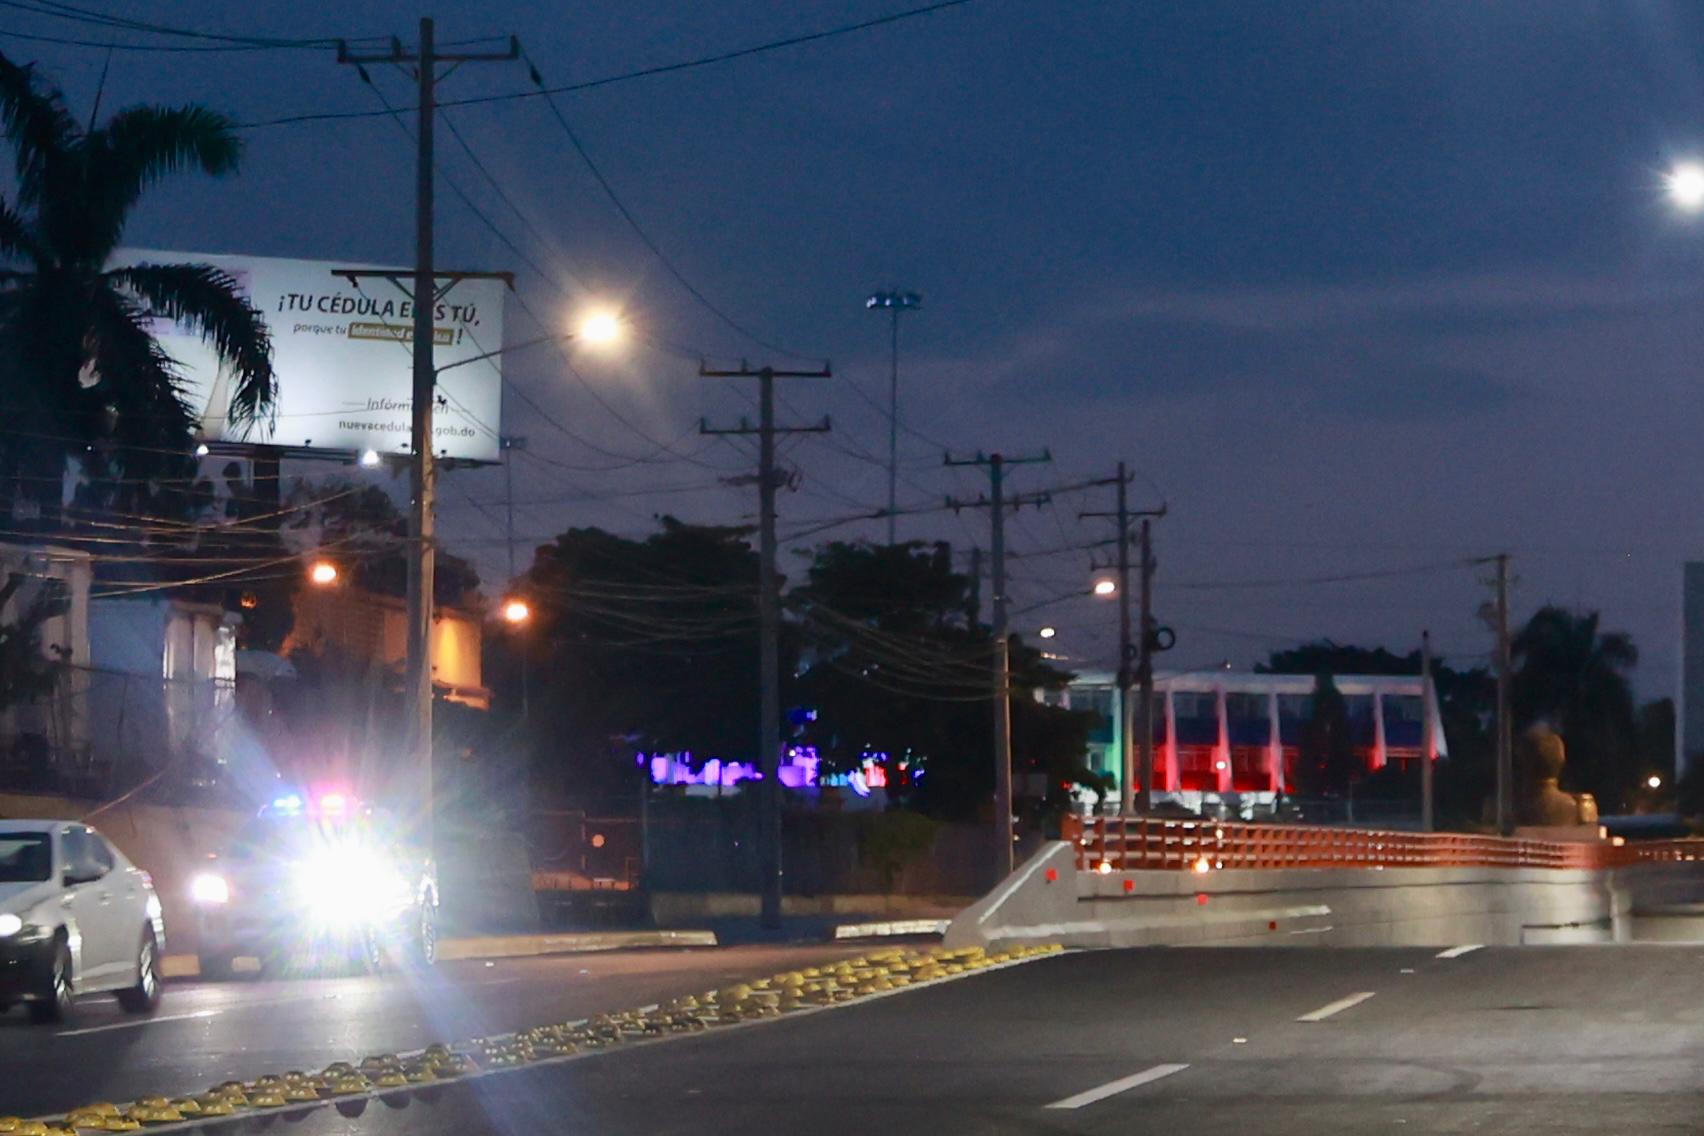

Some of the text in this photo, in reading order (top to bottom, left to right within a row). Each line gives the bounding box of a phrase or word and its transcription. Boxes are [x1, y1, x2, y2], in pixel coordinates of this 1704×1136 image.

[278, 292, 481, 327] ¡TU CÉDULA ES TÚ,
[293, 322, 332, 337] porque
[335, 323, 348, 335] tu
[367, 397, 424, 412] Infórm
